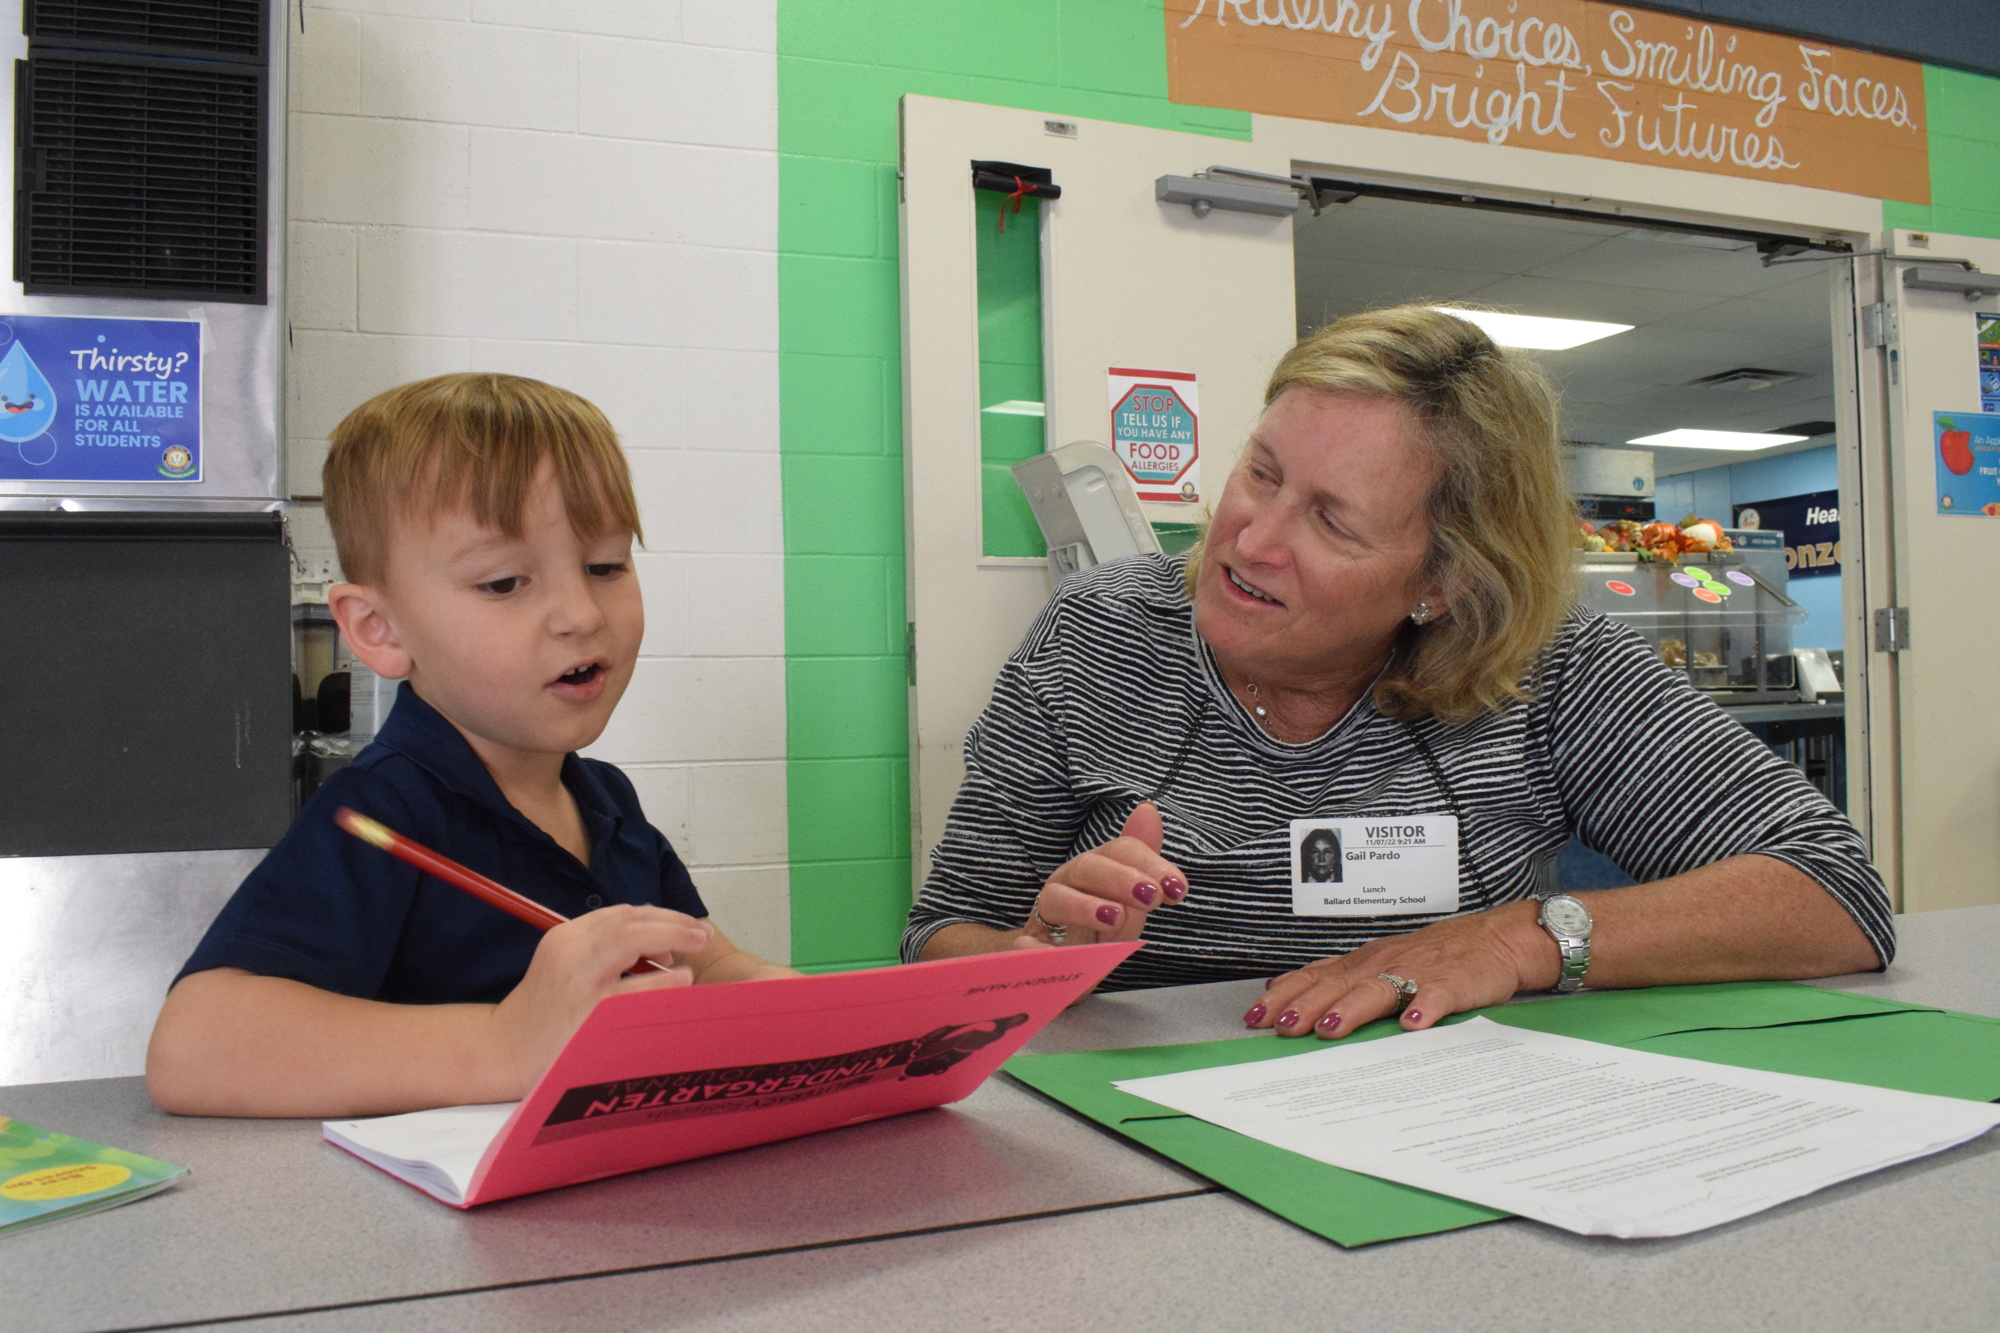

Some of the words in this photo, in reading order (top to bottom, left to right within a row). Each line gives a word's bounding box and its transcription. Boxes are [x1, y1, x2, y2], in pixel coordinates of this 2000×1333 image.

[1408, 0, 1592, 76] Choices,
[1601, 10, 1787, 128] Smiling
[1799, 44, 1917, 134] Faces,
[1357, 51, 1576, 145] Bright
[1597, 80, 1800, 170] Futures
[70, 347, 189, 380] Thirsty?
[75, 379, 188, 403] WATER
[1132, 394, 1175, 412] STOP
[75, 404, 90, 417] IS
[94, 404, 184, 418] AVAILABLE
[75, 418, 108, 432] FOR
[112, 420, 140, 432] ALL
[1122, 413, 1148, 426] TELL
[1152, 414, 1167, 428] US
[1171, 416, 1181, 428] IF
[75, 434, 161, 447] STUDENTS
[1117, 427, 1138, 437] YOU
[1141, 428, 1168, 439] HAVE
[1170, 430, 1191, 440] ANY
[1129, 442, 1180, 460] FOOD
[1131, 461, 1179, 472] ALLERGIES
[1980, 467, 1998, 475] FRUIT
[1806, 506, 1840, 526] Hea
[1365, 825, 1425, 838] VISITOR
[1345, 851, 1366, 861] Gail
[1369, 850, 1401, 860] Pardo
[1353, 897, 1397, 906] Elementary
[1399, 896, 1426, 904] School
[1012, 972, 1083, 988] STUDENT
[963, 983, 1011, 996] NAME
[584, 1054, 895, 1117] KINDERGARTEN
[606, 1066, 764, 1096] JOURNAL
